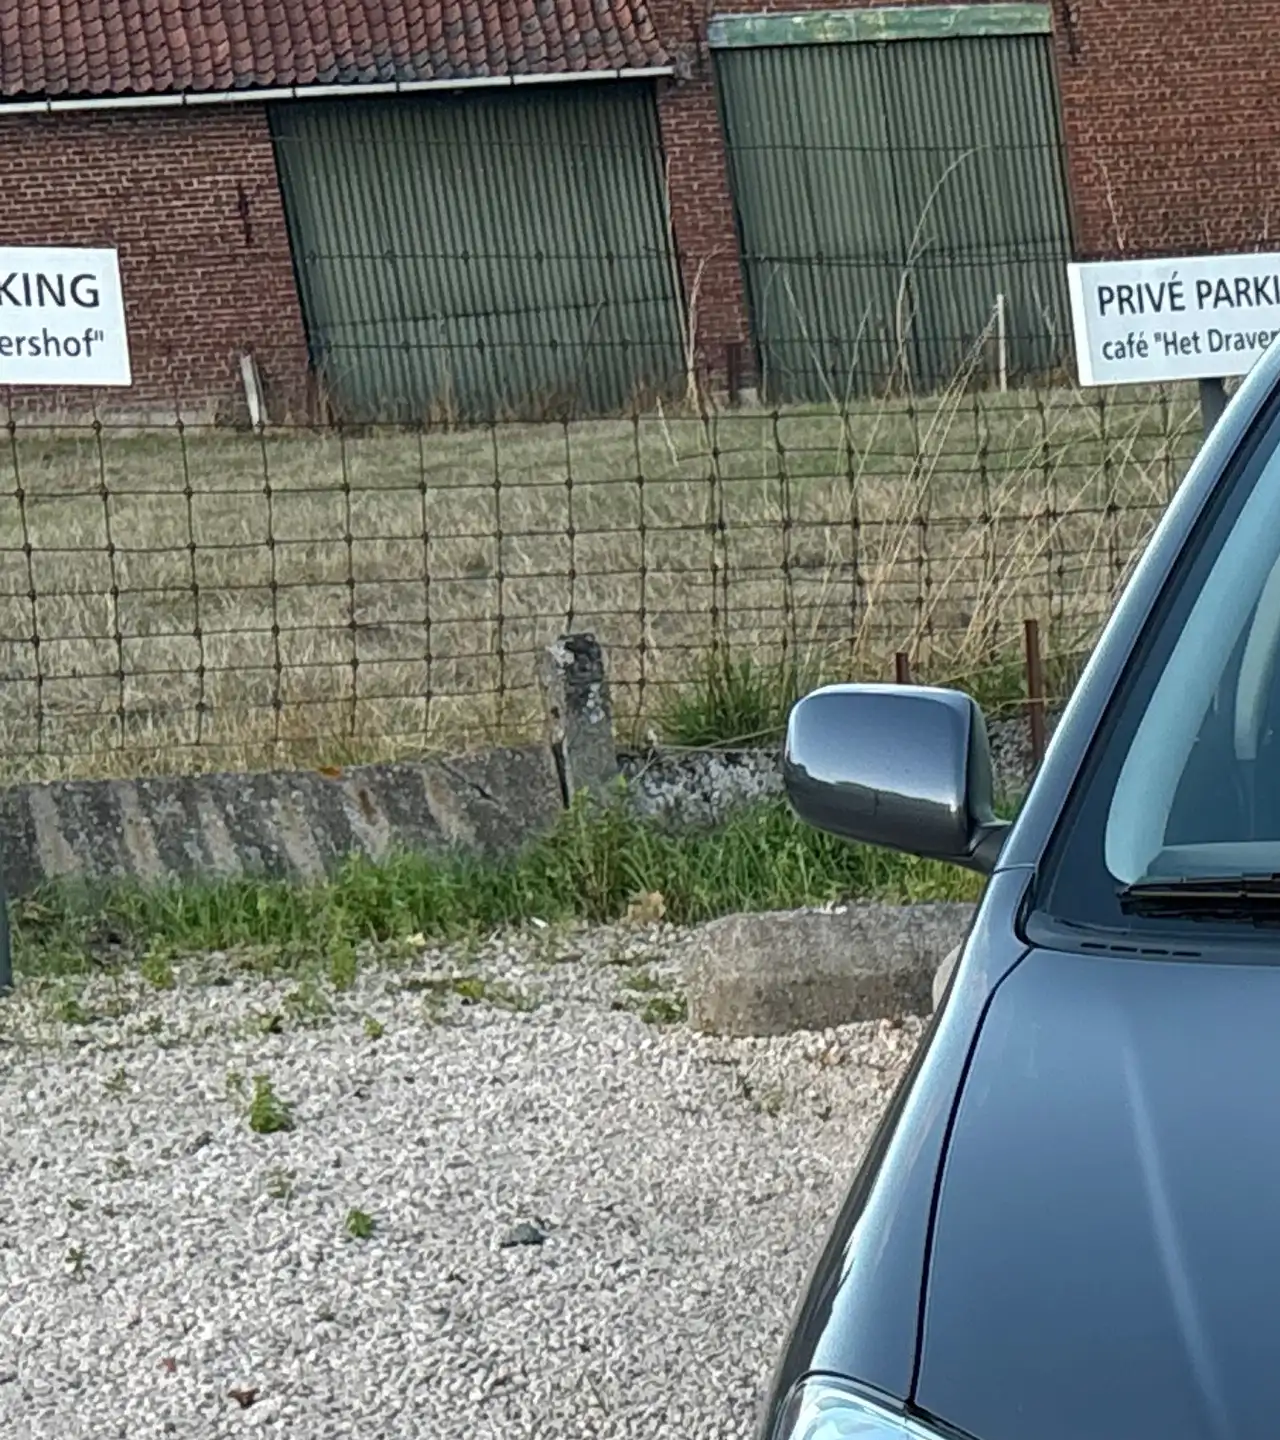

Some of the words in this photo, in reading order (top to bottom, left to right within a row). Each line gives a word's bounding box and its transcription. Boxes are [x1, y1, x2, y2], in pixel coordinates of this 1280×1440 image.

[1097, 270, 1186, 316] PRIVÉ
[1102, 331, 1149, 361] café
[1153, 330, 1202, 357] "Het
